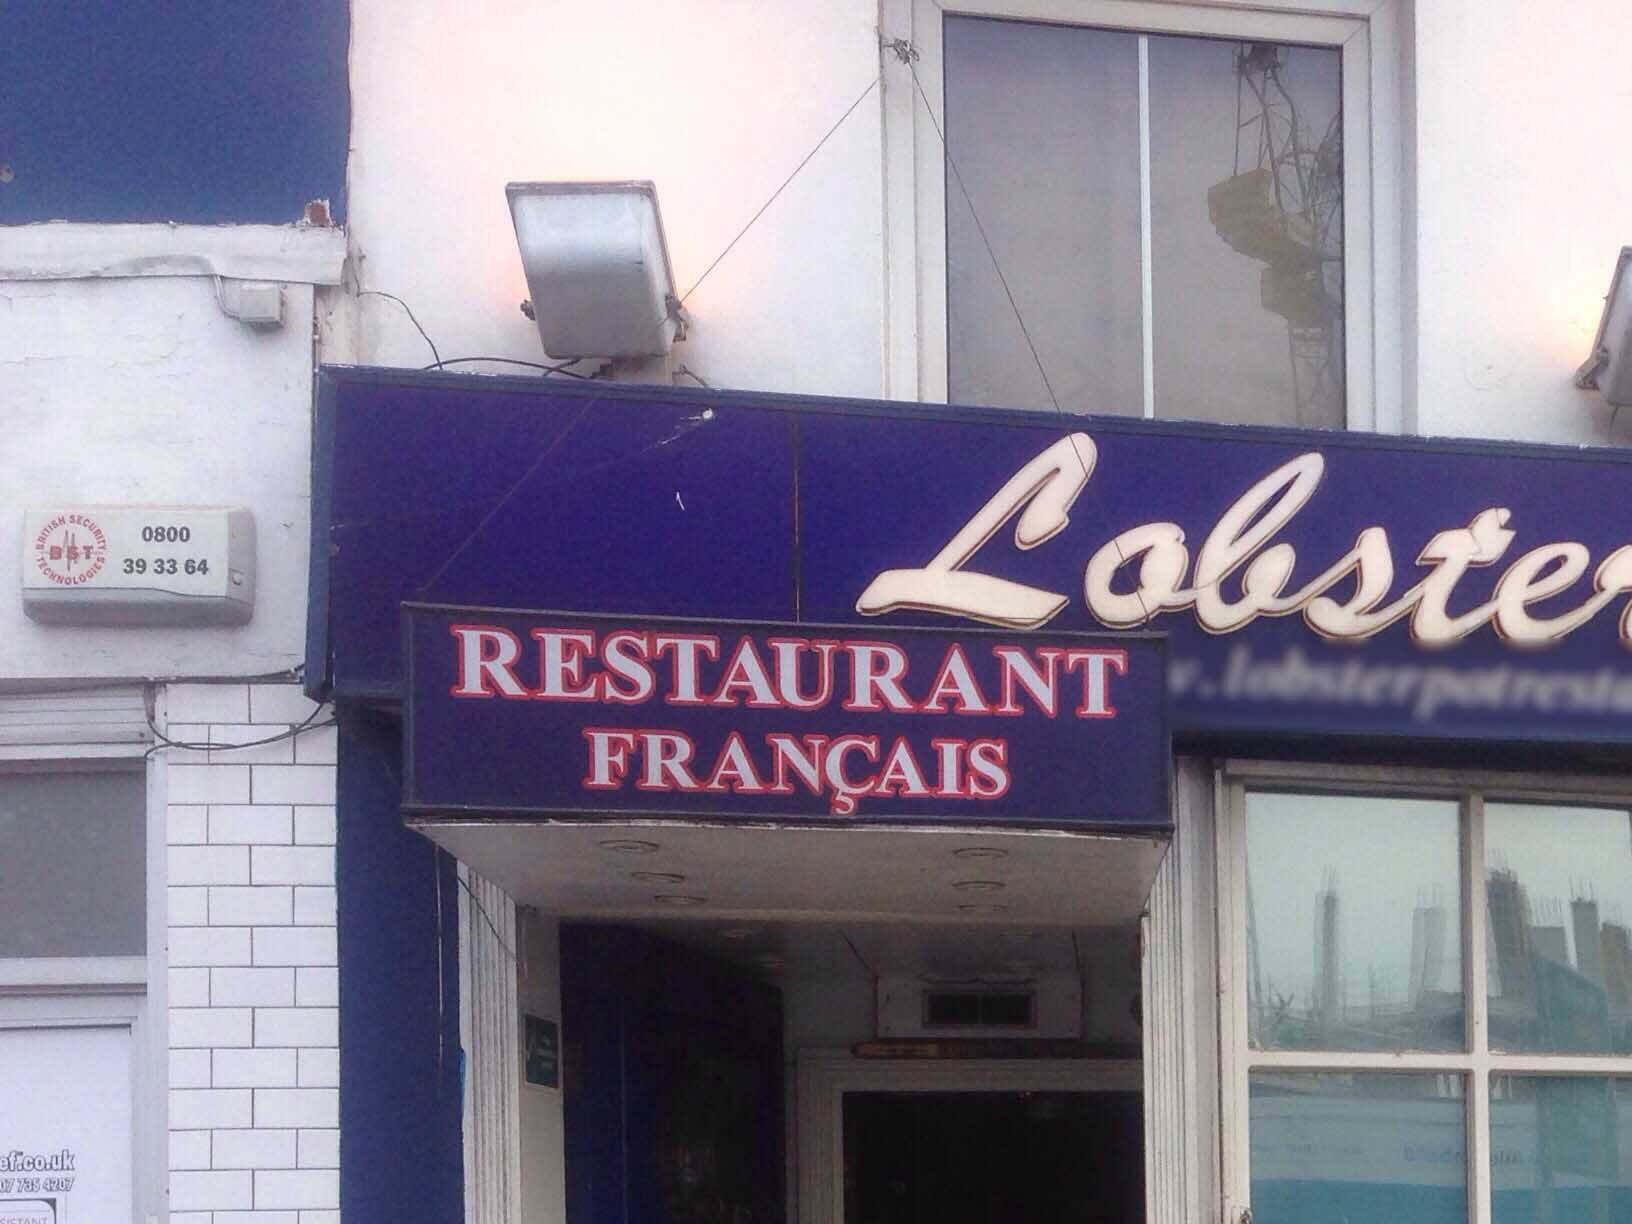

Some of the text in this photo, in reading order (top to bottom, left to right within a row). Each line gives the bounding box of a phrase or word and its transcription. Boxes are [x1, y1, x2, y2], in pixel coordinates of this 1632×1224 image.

[35, 515, 106, 550] BRITISH SECURITY
[141, 526, 191, 543] 0800
[36, 556, 105, 585] TECHNOLOGIES
[122, 559, 209, 575] 39 33 64
[450, 624, 1128, 719] RESTAURANT
[583, 728, 1010, 815] FRANÇAIS
